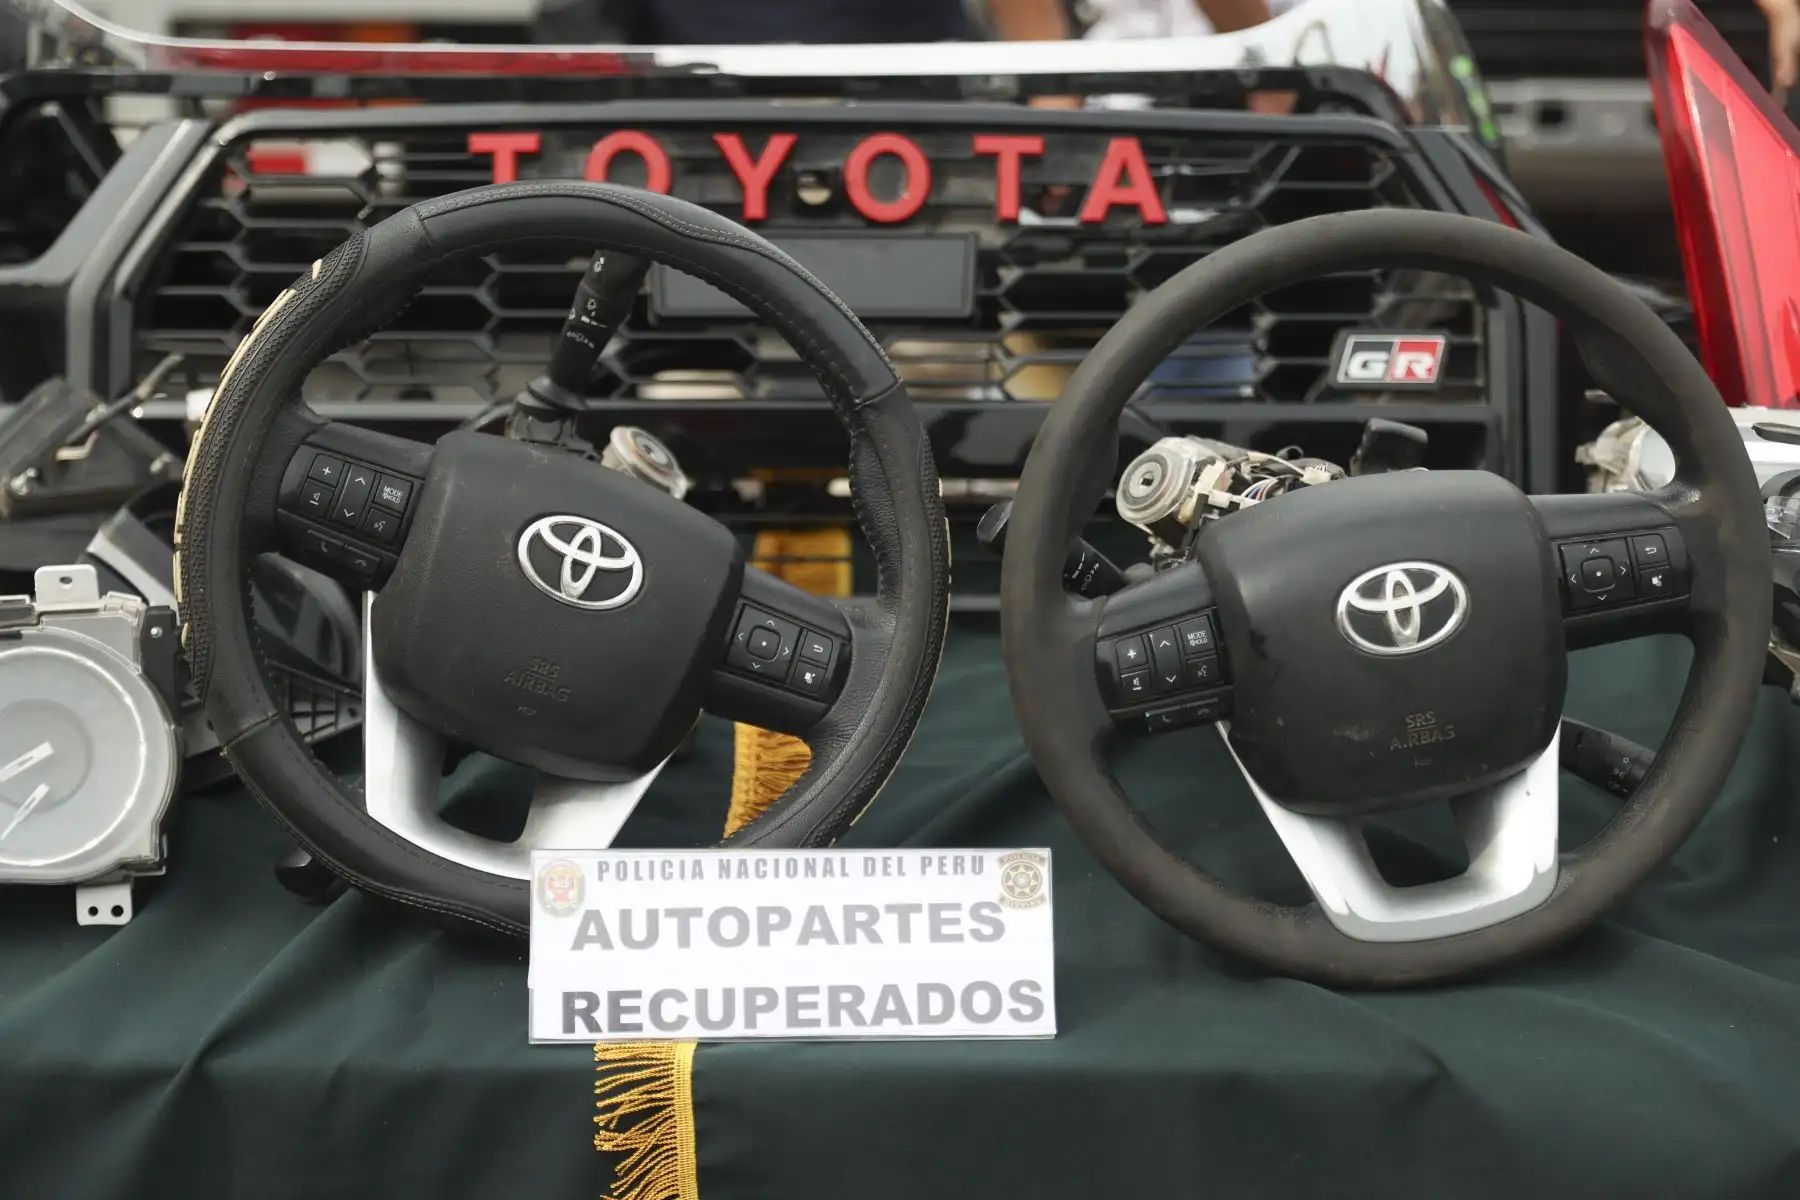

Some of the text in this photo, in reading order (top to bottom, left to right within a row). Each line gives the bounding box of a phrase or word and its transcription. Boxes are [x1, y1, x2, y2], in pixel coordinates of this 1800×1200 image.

[467, 129, 1168, 224] TOYOTA
[1346, 351, 1436, 380] GR
[384, 486, 402, 498] MODE
[1187, 631, 1206, 640] MODE
[1405, 710, 1436, 728] SRS
[597, 858, 704, 882] POLICIA
[717, 856, 850, 880] NACIONAL
[862, 855, 906, 878] DEL
[919, 854, 985, 876] PERU
[570, 901, 1006, 951] AUTOPARTES
[561, 979, 1045, 1035] RECUPERADOS
